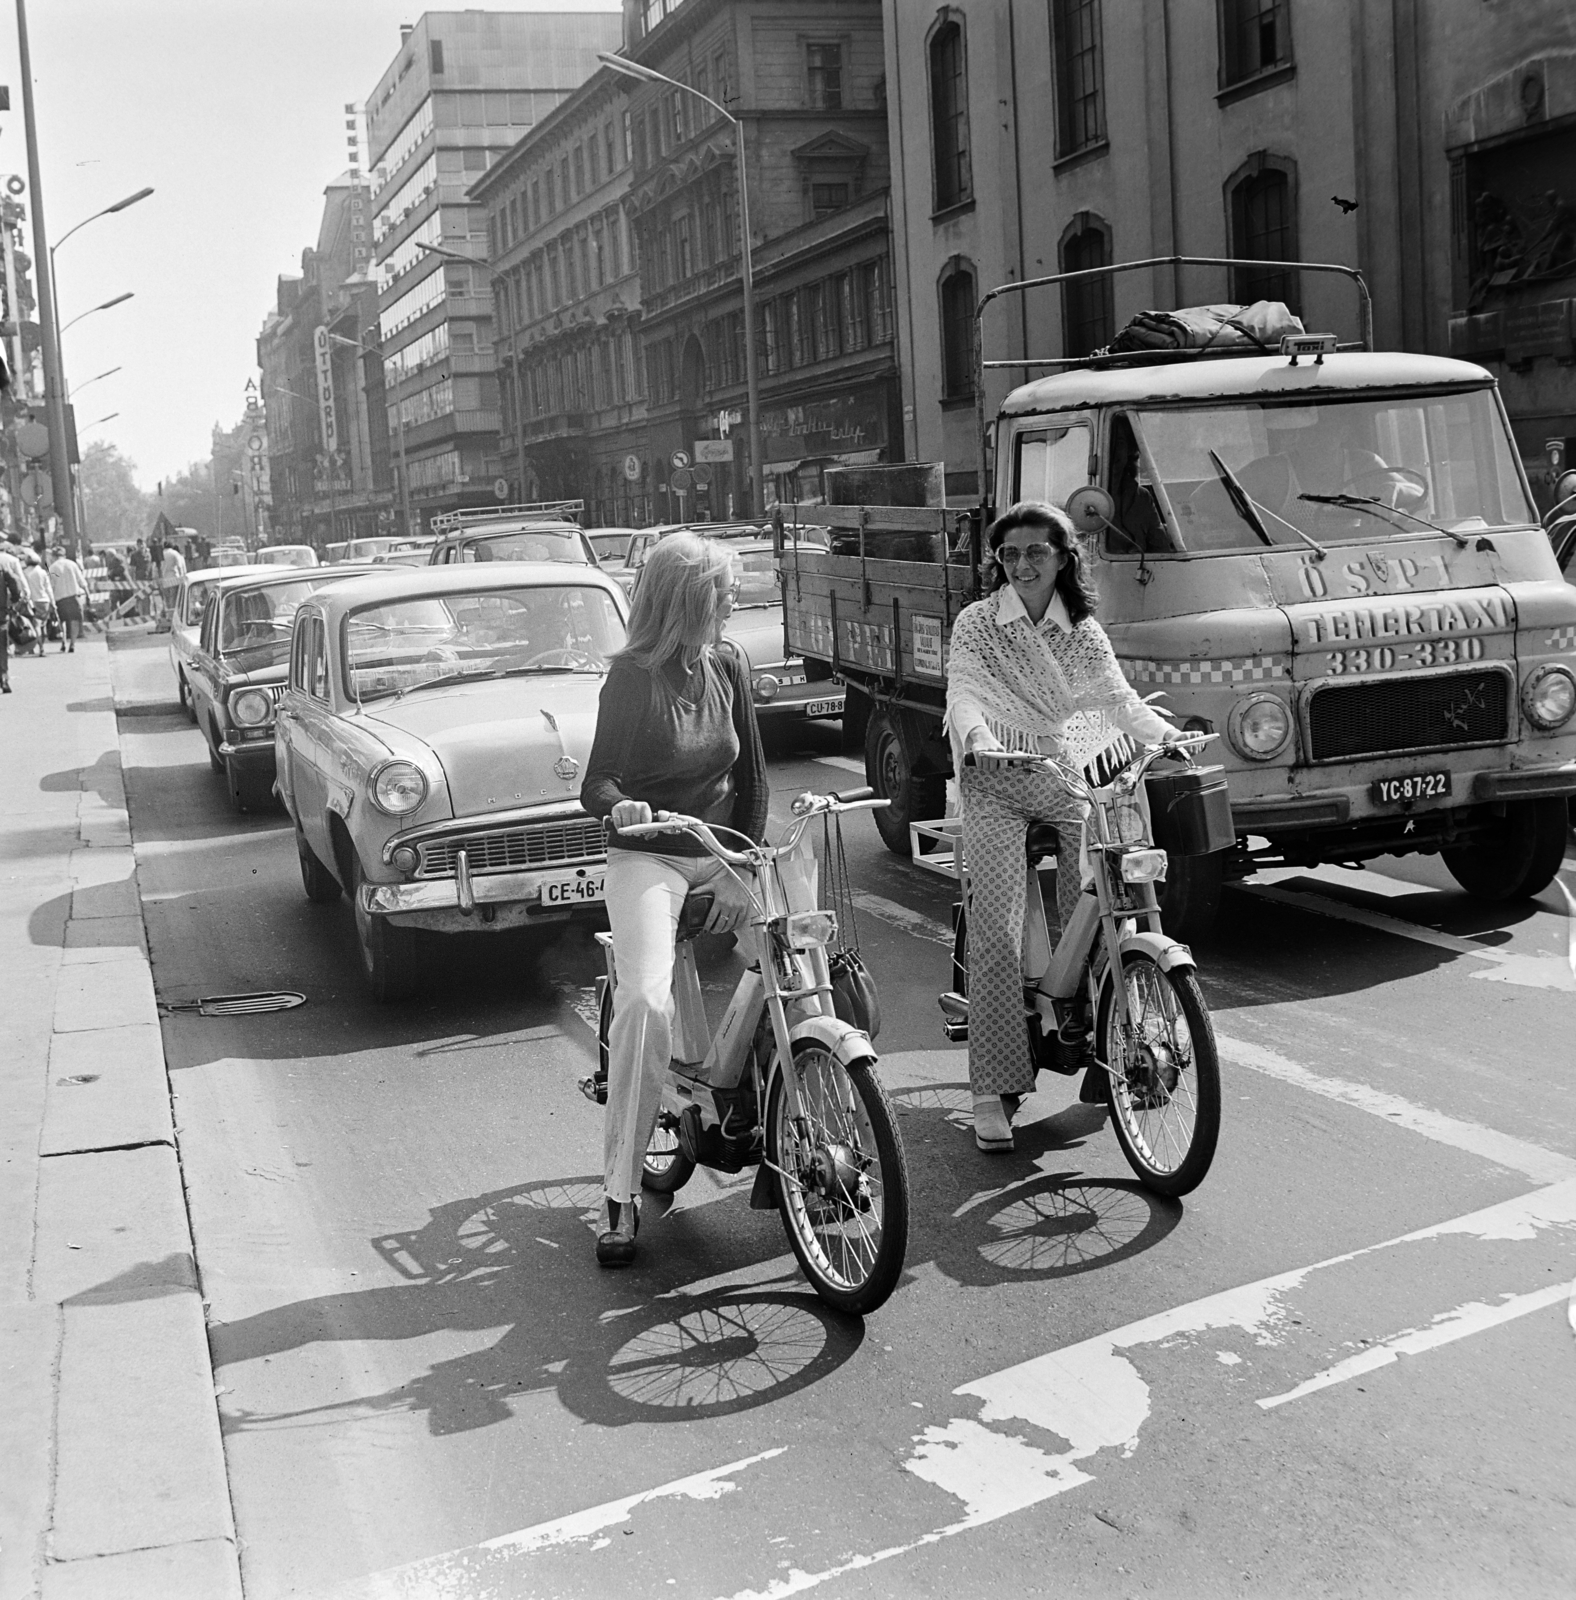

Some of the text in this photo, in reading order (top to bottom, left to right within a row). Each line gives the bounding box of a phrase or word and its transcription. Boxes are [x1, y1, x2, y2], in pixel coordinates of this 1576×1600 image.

[1293, 341, 1325, 352] Taxi
[1301, 597, 1510, 644] TEHERTAXI
[1325, 637, 1484, 676] 330-330
[810, 701, 843, 714] CU-78-8
[548, 878, 605, 902] CE-46-
